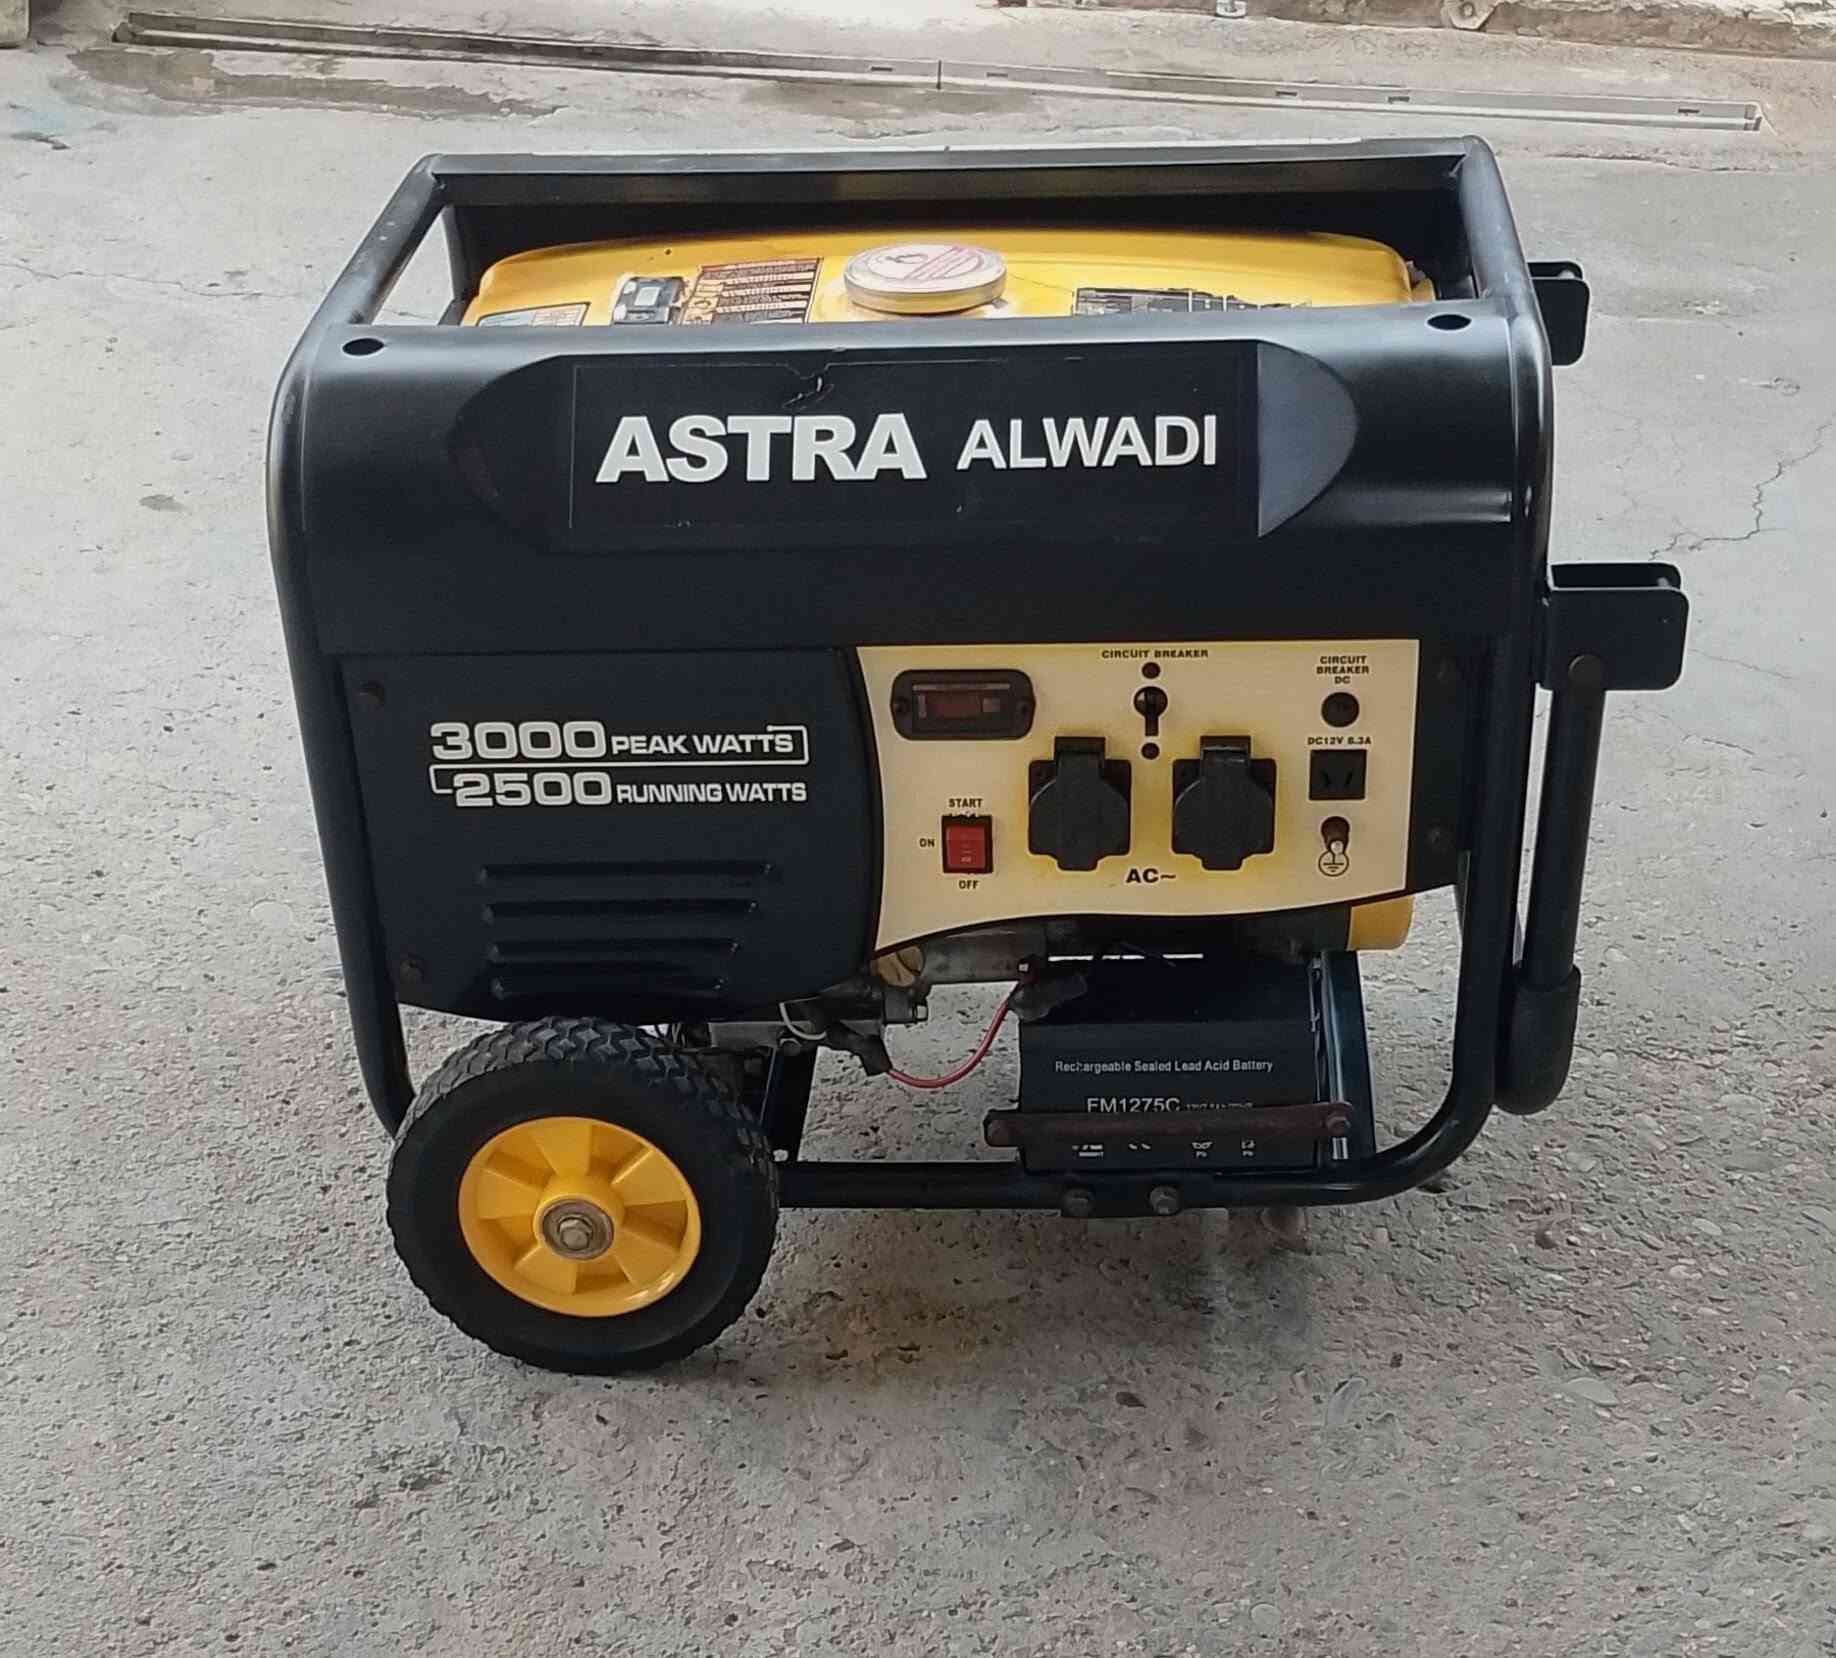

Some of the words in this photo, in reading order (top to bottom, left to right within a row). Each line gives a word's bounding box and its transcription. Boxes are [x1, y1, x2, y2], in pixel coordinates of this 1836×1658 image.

[595, 413, 928, 483] ASTRA
[956, 415, 1217, 470] ALWADI
[1102, 650, 1149, 659] CIRCUIT
[1154, 649, 1208, 658] BREAKER
[1320, 656, 1367, 665] CIRCUIT
[1316, 665, 1369, 675] BREAKER
[1334, 675, 1351, 684] DC
[430, 721, 606, 760] 3000
[611, 735, 688, 755] PEAK
[694, 733, 794, 754] WATTS
[1307, 736, 1343, 745] DC12V
[453, 772, 612, 808] 2500
[616, 783, 722, 803] RUNNING
[725, 782, 807, 802] WATTS
[948, 798, 983, 808] START
[919, 838, 935, 848] ON
[958, 880, 978, 889] OFF
[1055, 1060, 1132, 1074] Rechargeable
[1134, 1059, 1172, 1072] Sealed
[1174, 1059, 1202, 1071] Lead
[1204, 1059, 1230, 1072] Acid
[1232, 1059, 1274, 1073] Battery
